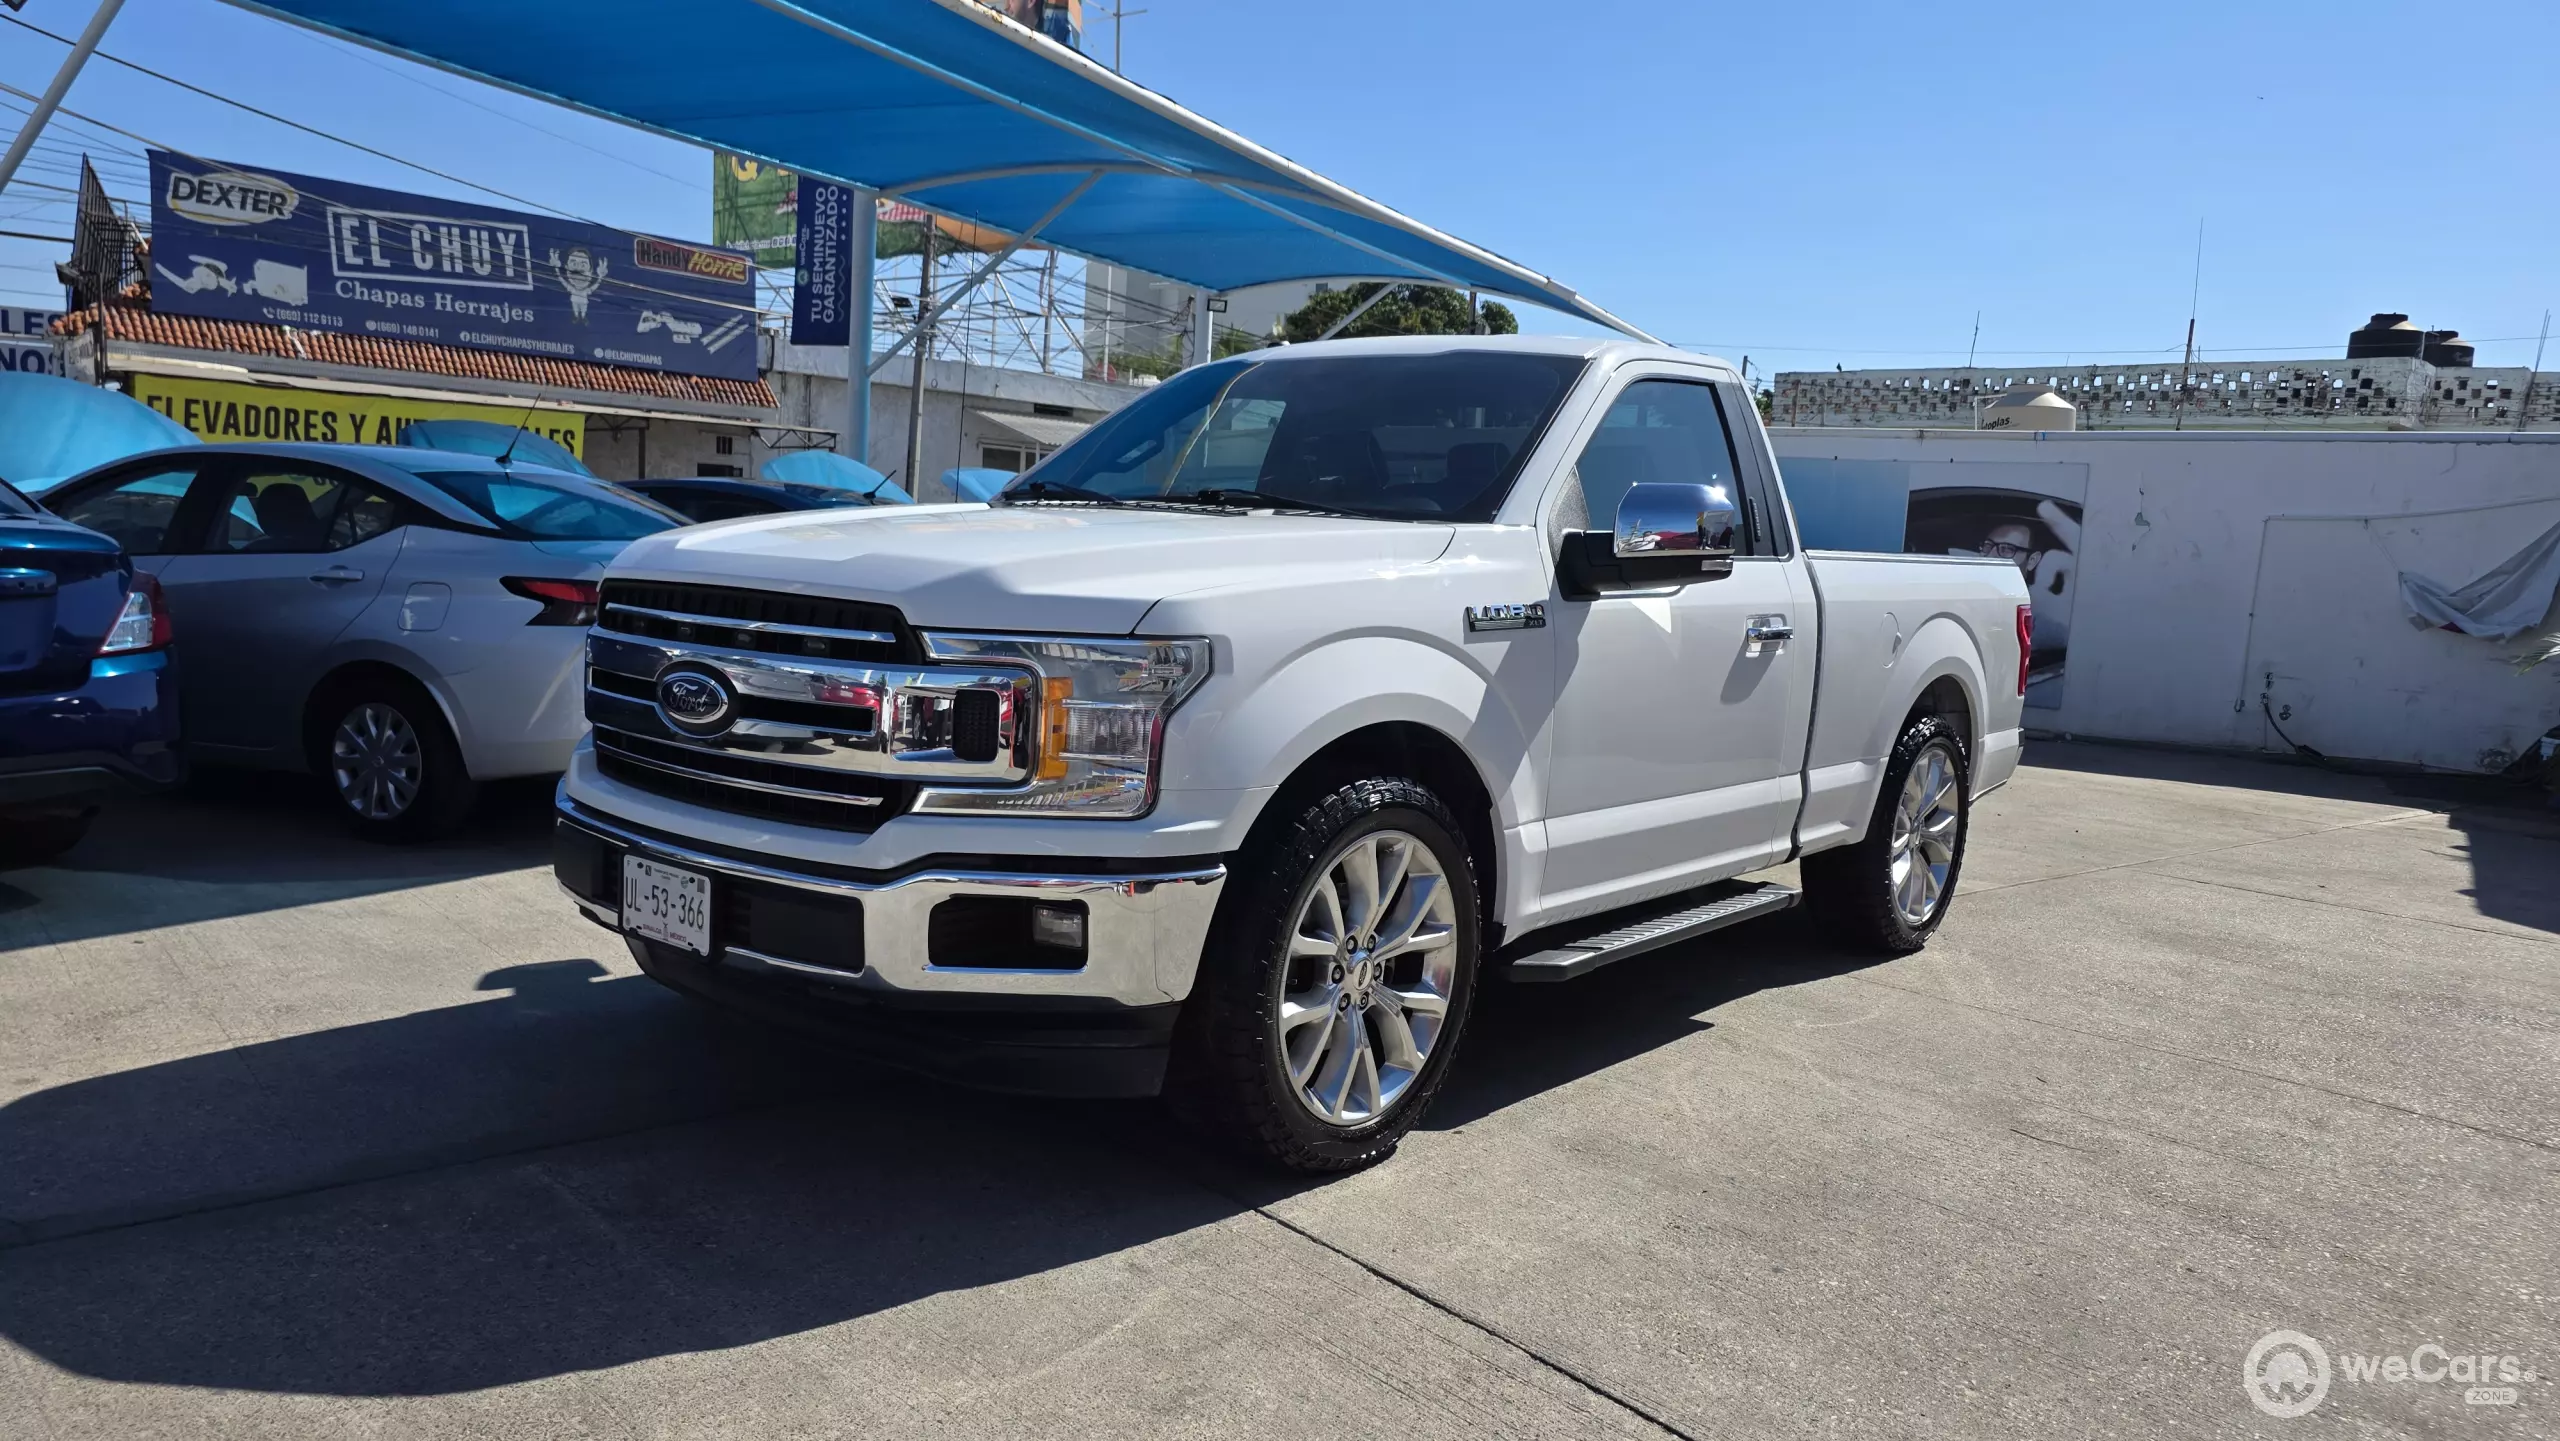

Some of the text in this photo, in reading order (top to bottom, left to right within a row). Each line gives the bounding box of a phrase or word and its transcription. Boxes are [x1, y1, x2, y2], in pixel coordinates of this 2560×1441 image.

[171, 175, 289, 217] DEXTER
[340, 216, 517, 277] EL CHUY
[811, 187, 826, 323] TU SEMINUEVO
[823, 186, 839, 323] GARANTIZADO
[335, 280, 535, 324] Chapas Herrajes
[348, 413, 367, 444] Y
[1529, 619, 1544, 627] XLT
[670, 682, 711, 712] Ford
